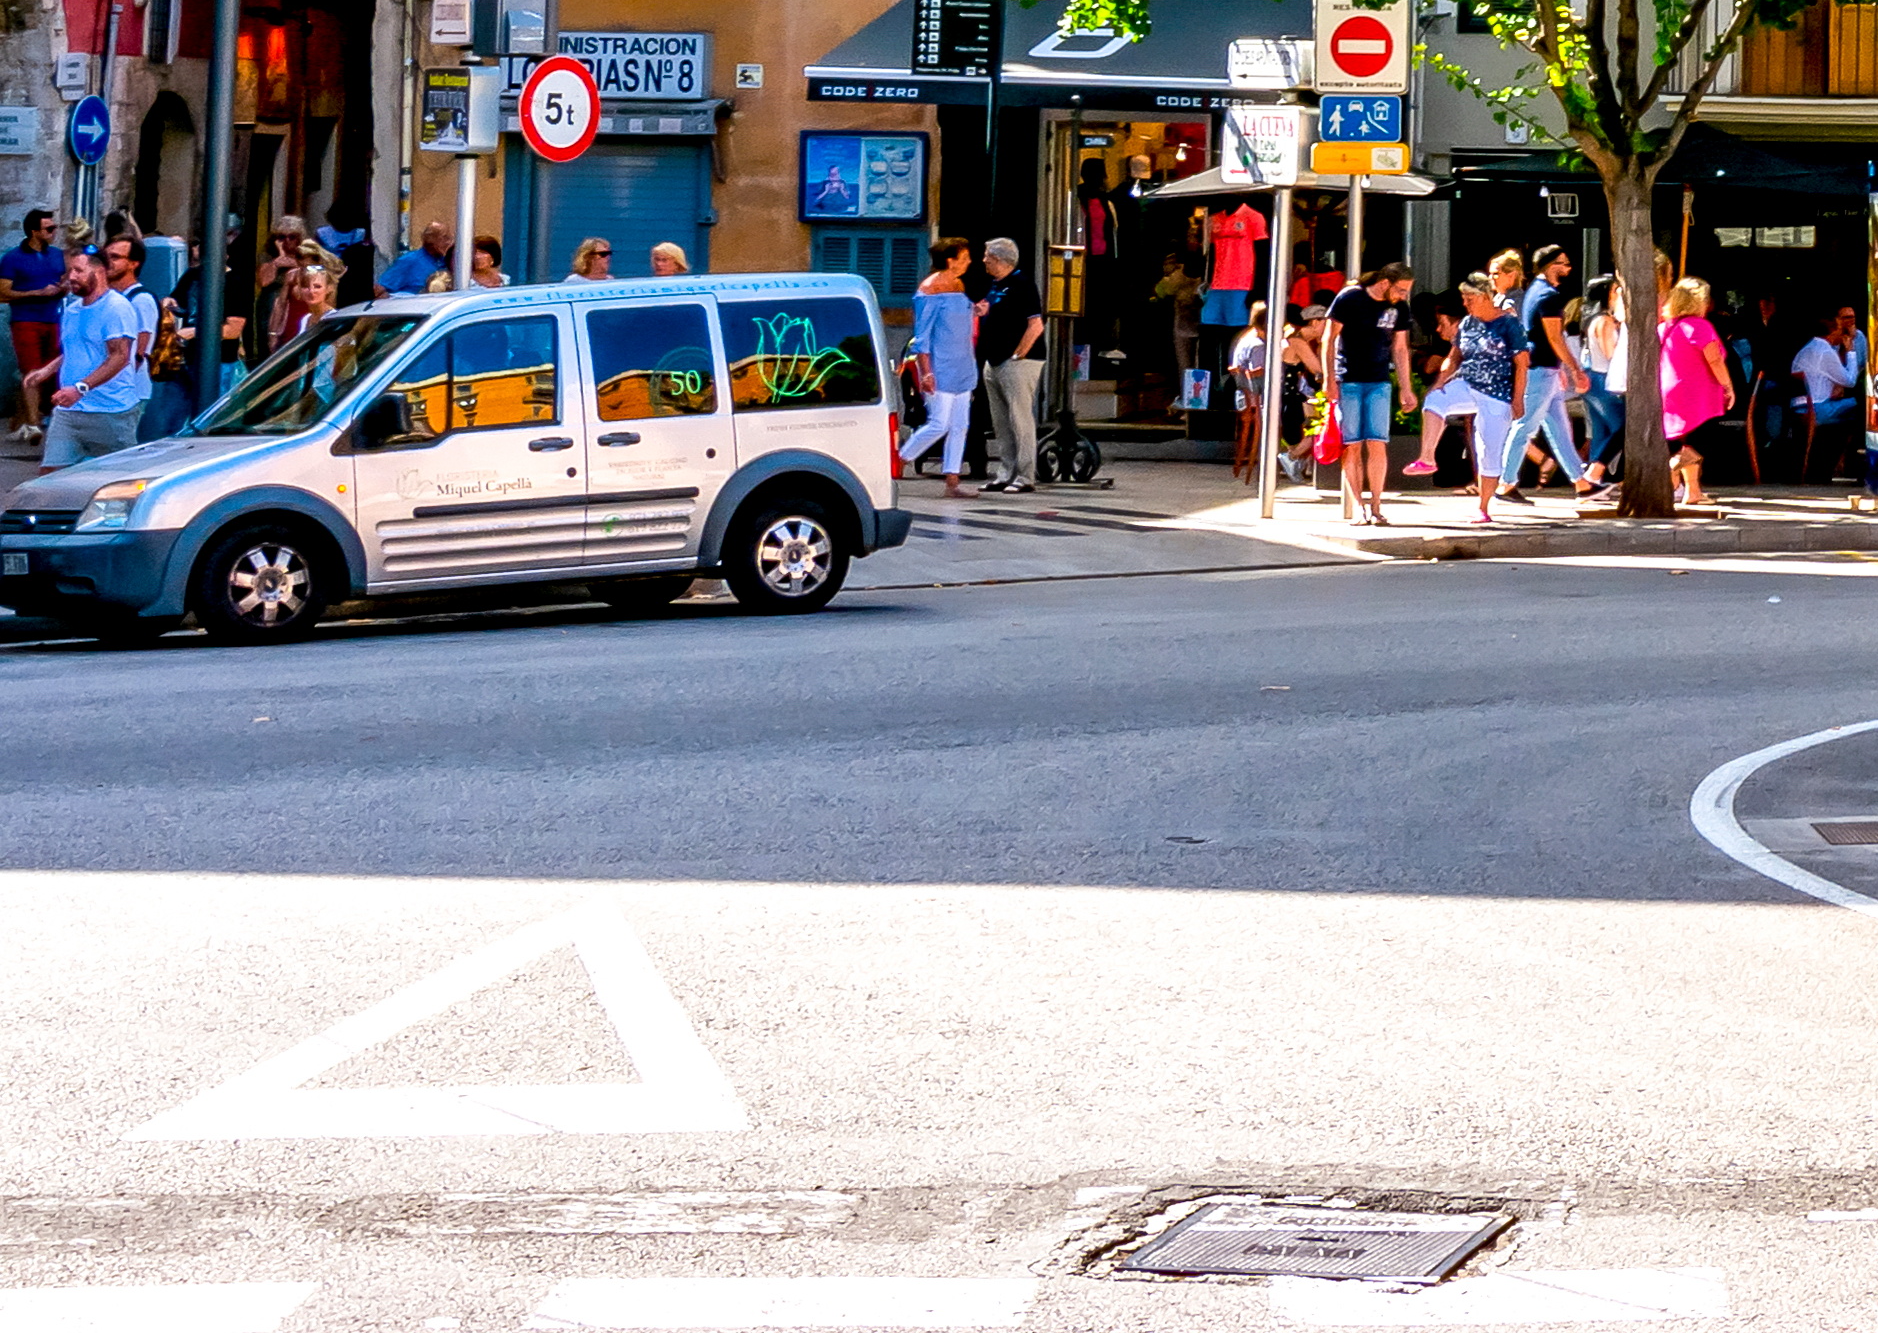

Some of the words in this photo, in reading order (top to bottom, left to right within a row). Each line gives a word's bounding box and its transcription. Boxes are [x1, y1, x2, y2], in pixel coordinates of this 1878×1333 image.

[560, 37, 697, 56] INISTRACION
[678, 59, 694, 93] 8
[821, 86, 867, 97] CODE
[873, 87, 919, 98] ZERO
[1156, 95, 1203, 107] CODE
[670, 370, 701, 396] 50
[437, 481, 482, 498] Miquel
[485, 477, 533, 495] Capellà
